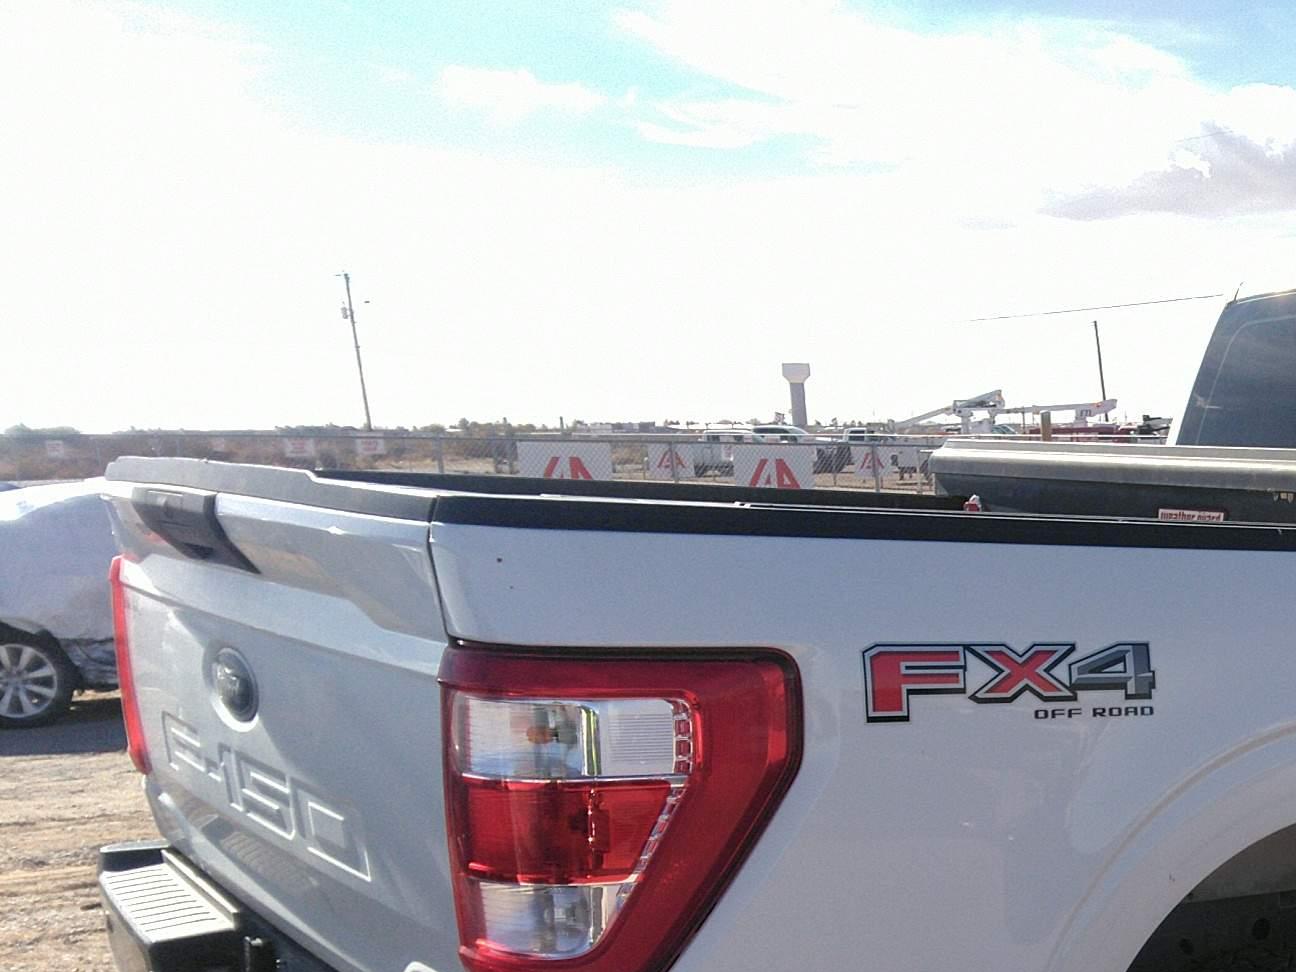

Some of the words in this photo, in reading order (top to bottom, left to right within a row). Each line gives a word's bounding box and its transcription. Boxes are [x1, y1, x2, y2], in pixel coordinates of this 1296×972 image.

[861, 641, 1156, 724] FX4
[1034, 708, 1082, 720] OFF
[1092, 706, 1155, 718] ROAD
[161, 710, 372, 882] F-150
